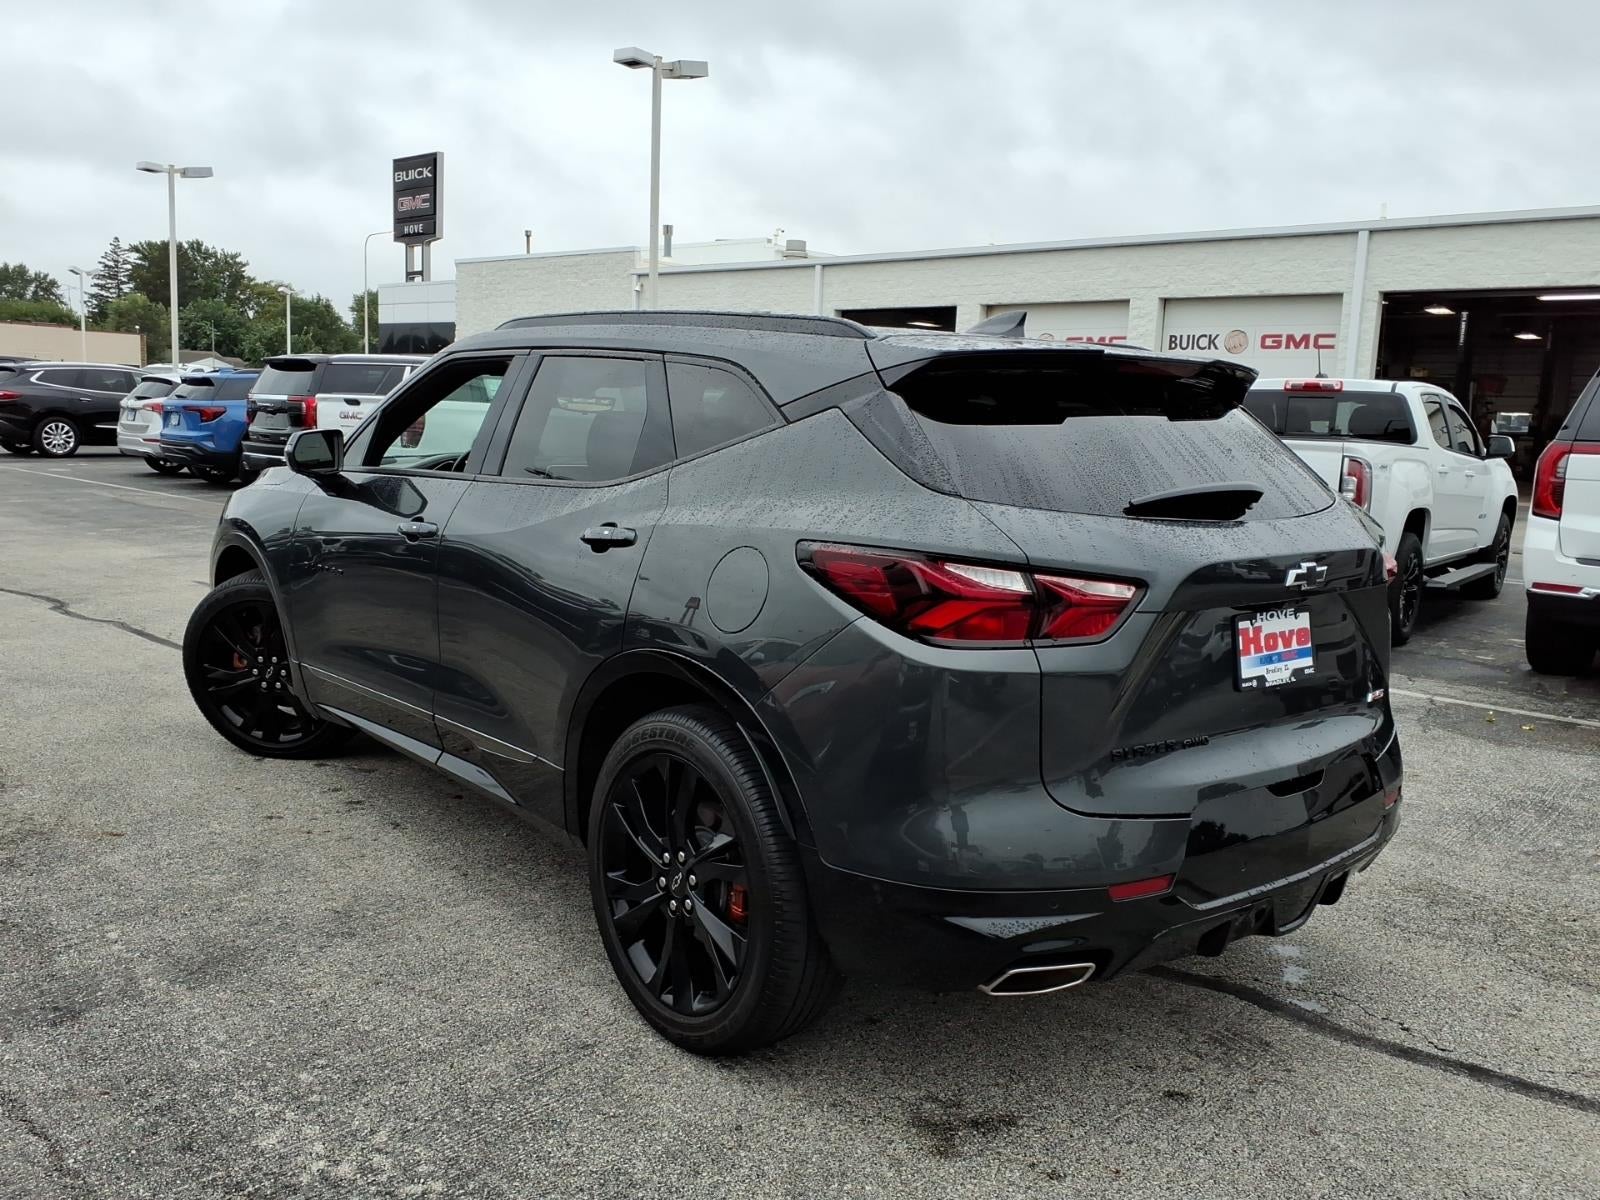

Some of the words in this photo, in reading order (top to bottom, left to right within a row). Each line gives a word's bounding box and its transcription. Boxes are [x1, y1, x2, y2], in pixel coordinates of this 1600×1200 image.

[394, 166, 432, 182] BUICK
[398, 193, 430, 212] GMC
[404, 223, 424, 235] HOVE
[1168, 333, 1219, 351] BUICK
[1259, 332, 1337, 350] GMC
[339, 410, 364, 420] GMC
[1256, 608, 1295, 622] HOVE
[1238, 625, 1311, 657] Hove
